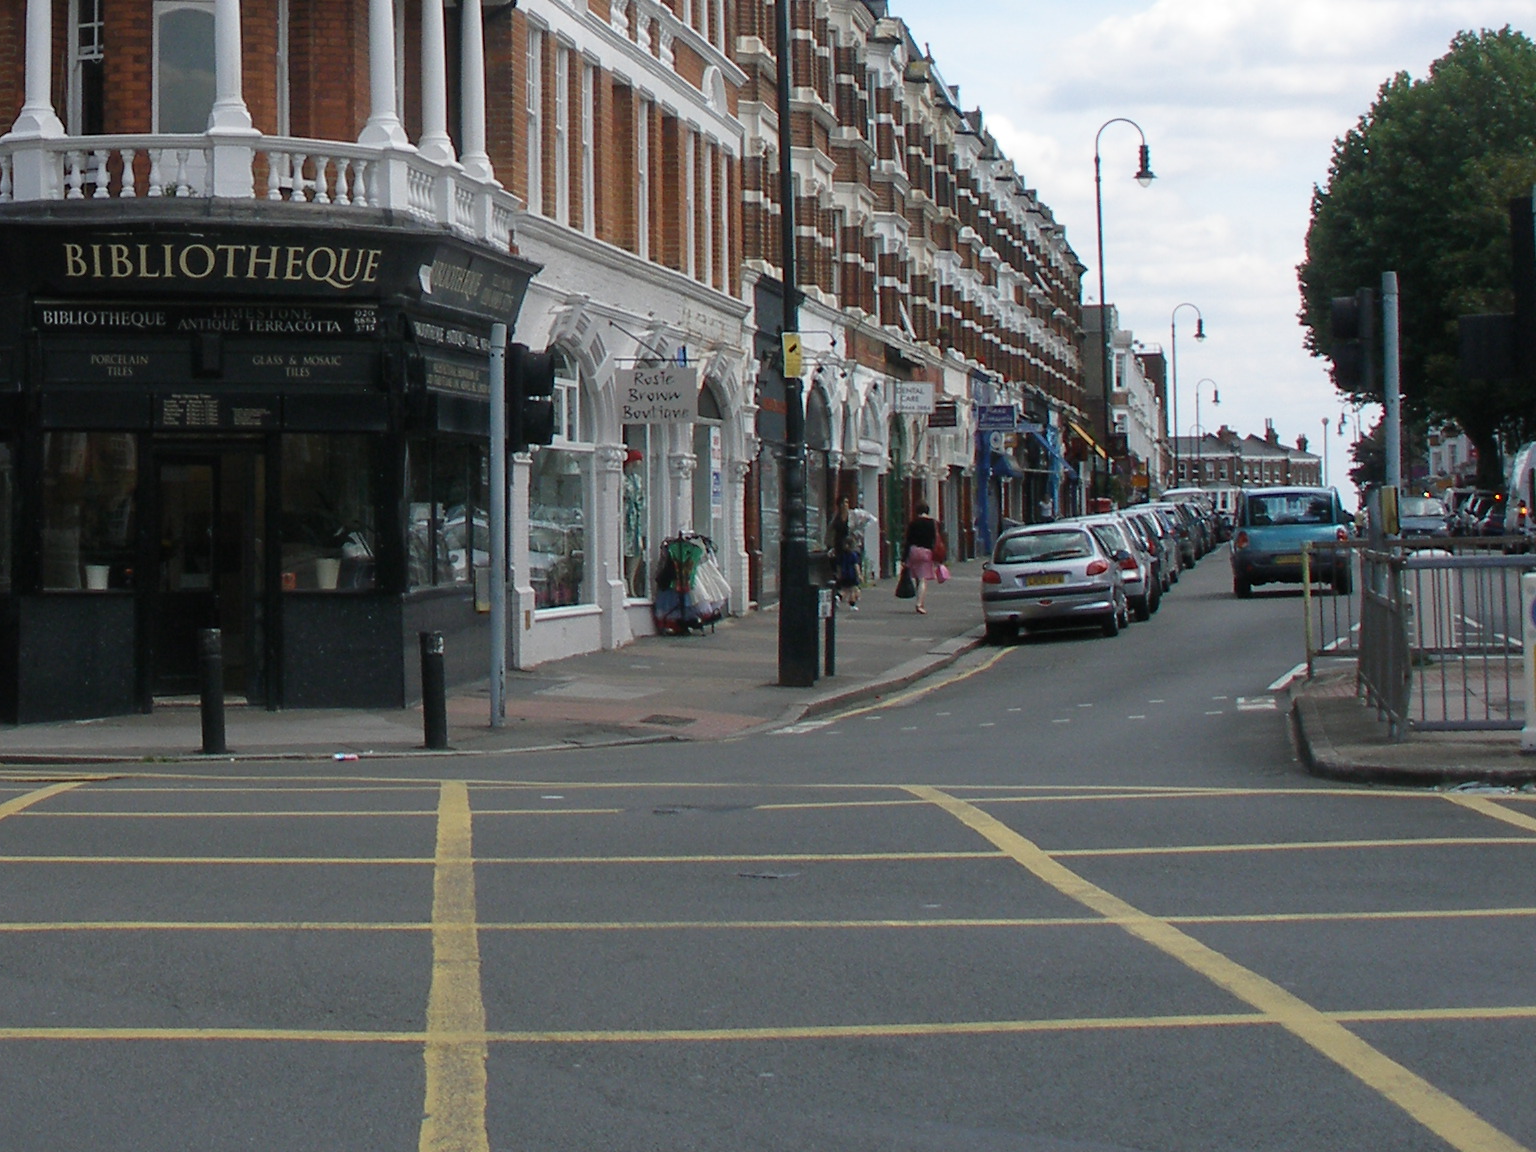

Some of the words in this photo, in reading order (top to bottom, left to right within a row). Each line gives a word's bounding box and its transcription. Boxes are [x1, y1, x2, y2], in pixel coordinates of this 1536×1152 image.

[63, 243, 382, 289] BIBLIOTHEQUE
[42, 310, 167, 328] BIBLIOTHEQUE
[212, 308, 312, 320] LIMESTONE
[177, 318, 240, 332] ANTIQUE
[248, 320, 342, 333] TERRACOTTA
[90, 354, 149, 365] PORCELAIN
[252, 355, 283, 366] GLASS
[289, 355, 297, 366] &
[303, 355, 342, 366] MOSAIC
[107, 366, 133, 377] TILES
[285, 367, 310, 378] TILES
[634, 371, 675, 386] Rosie
[628, 389, 681, 403] Brown
